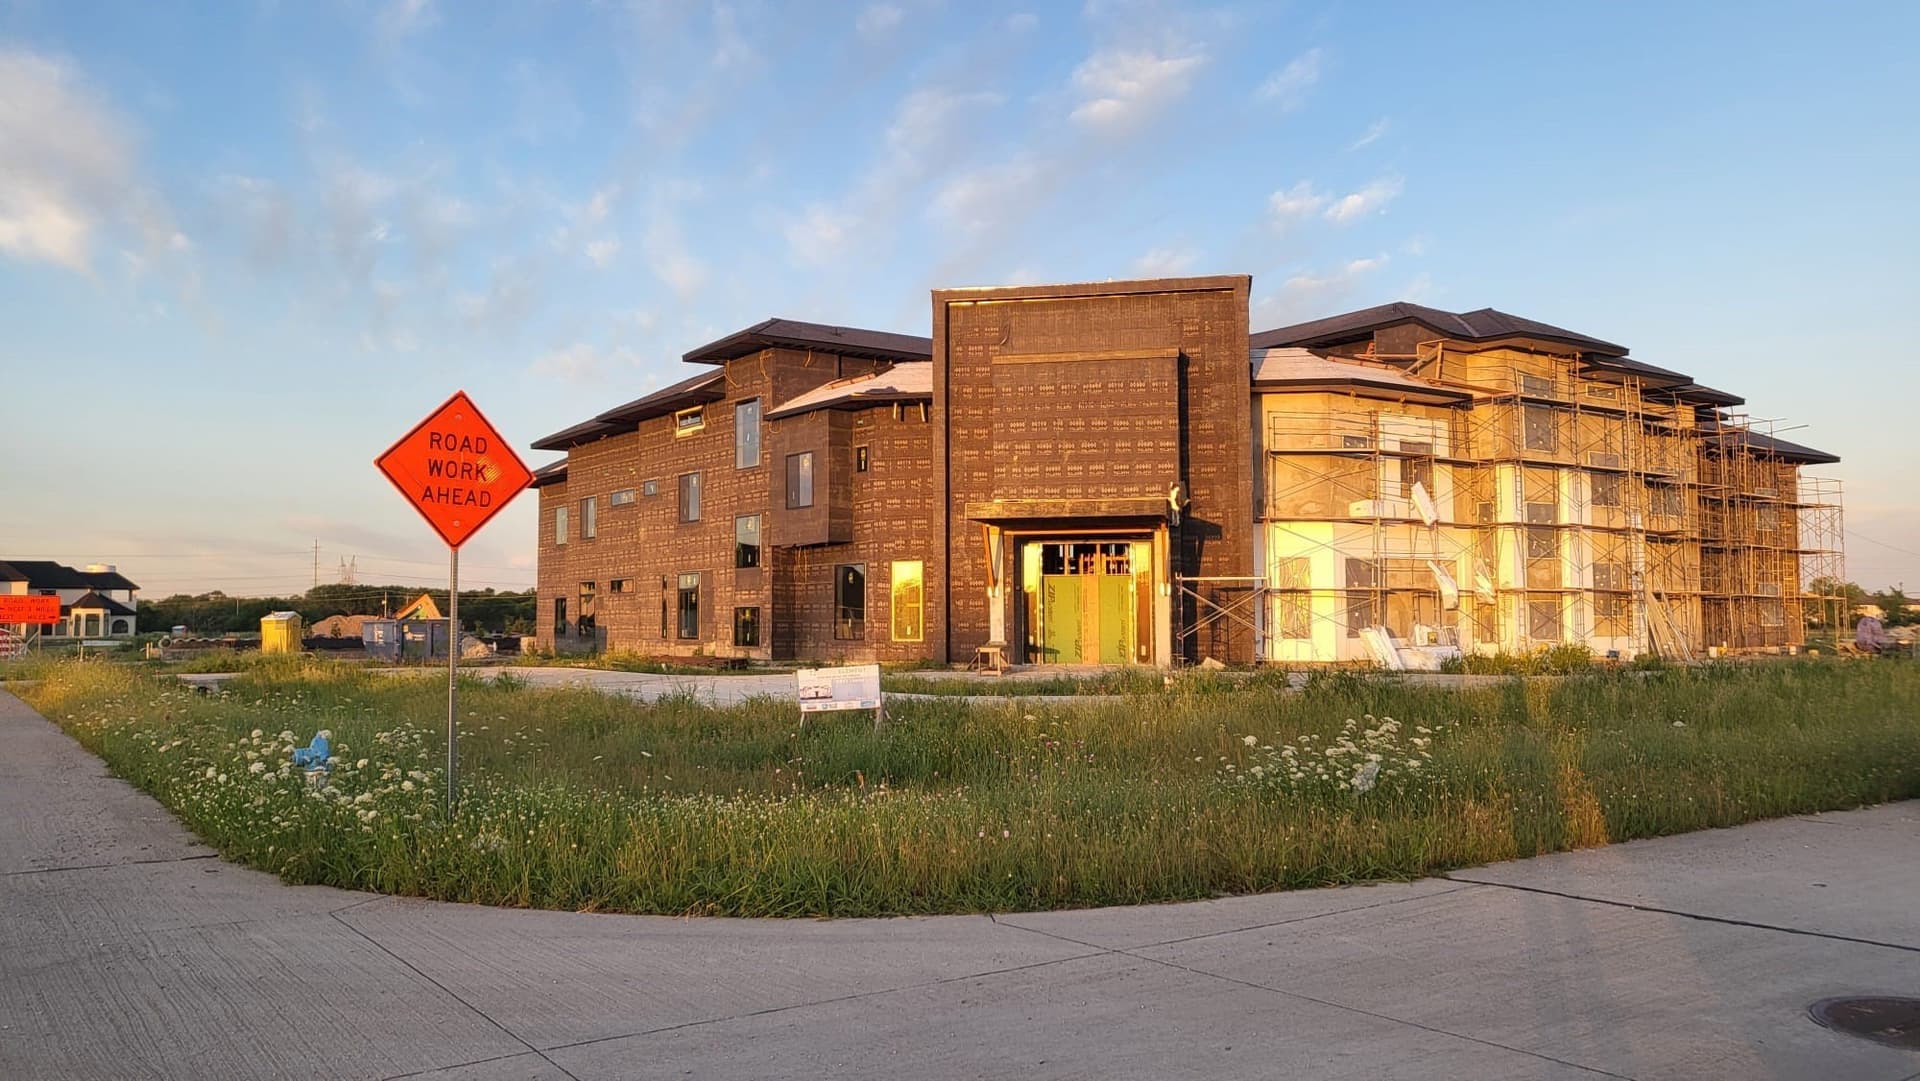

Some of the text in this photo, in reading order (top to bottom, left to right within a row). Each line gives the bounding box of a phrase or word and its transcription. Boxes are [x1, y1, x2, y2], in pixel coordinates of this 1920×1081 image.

[429, 432, 487, 454] ROAD
[428, 459, 487, 481] WORK
[421, 486, 491, 507] AHEAD
